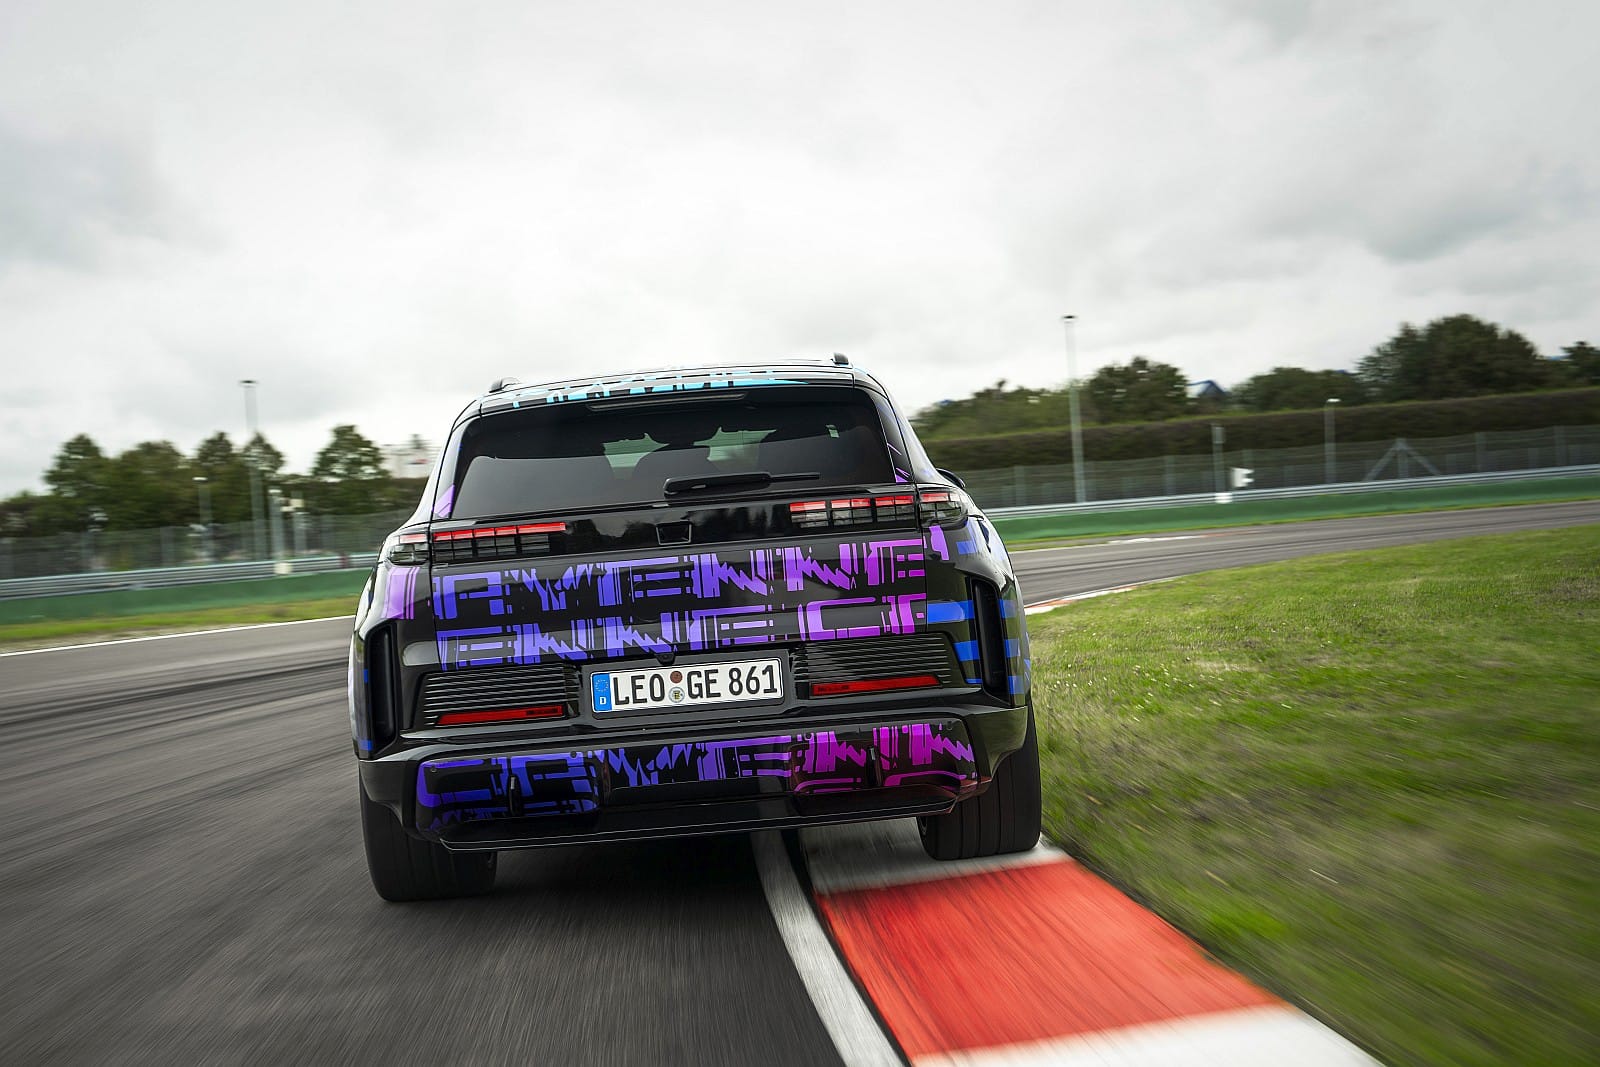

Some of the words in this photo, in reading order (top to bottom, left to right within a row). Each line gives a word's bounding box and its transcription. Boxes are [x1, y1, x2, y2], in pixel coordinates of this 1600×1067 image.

[613, 674, 665, 705] LEO
[687, 669, 721, 699] GE
[728, 665, 778, 696] 861
[599, 696, 607, 705] D
